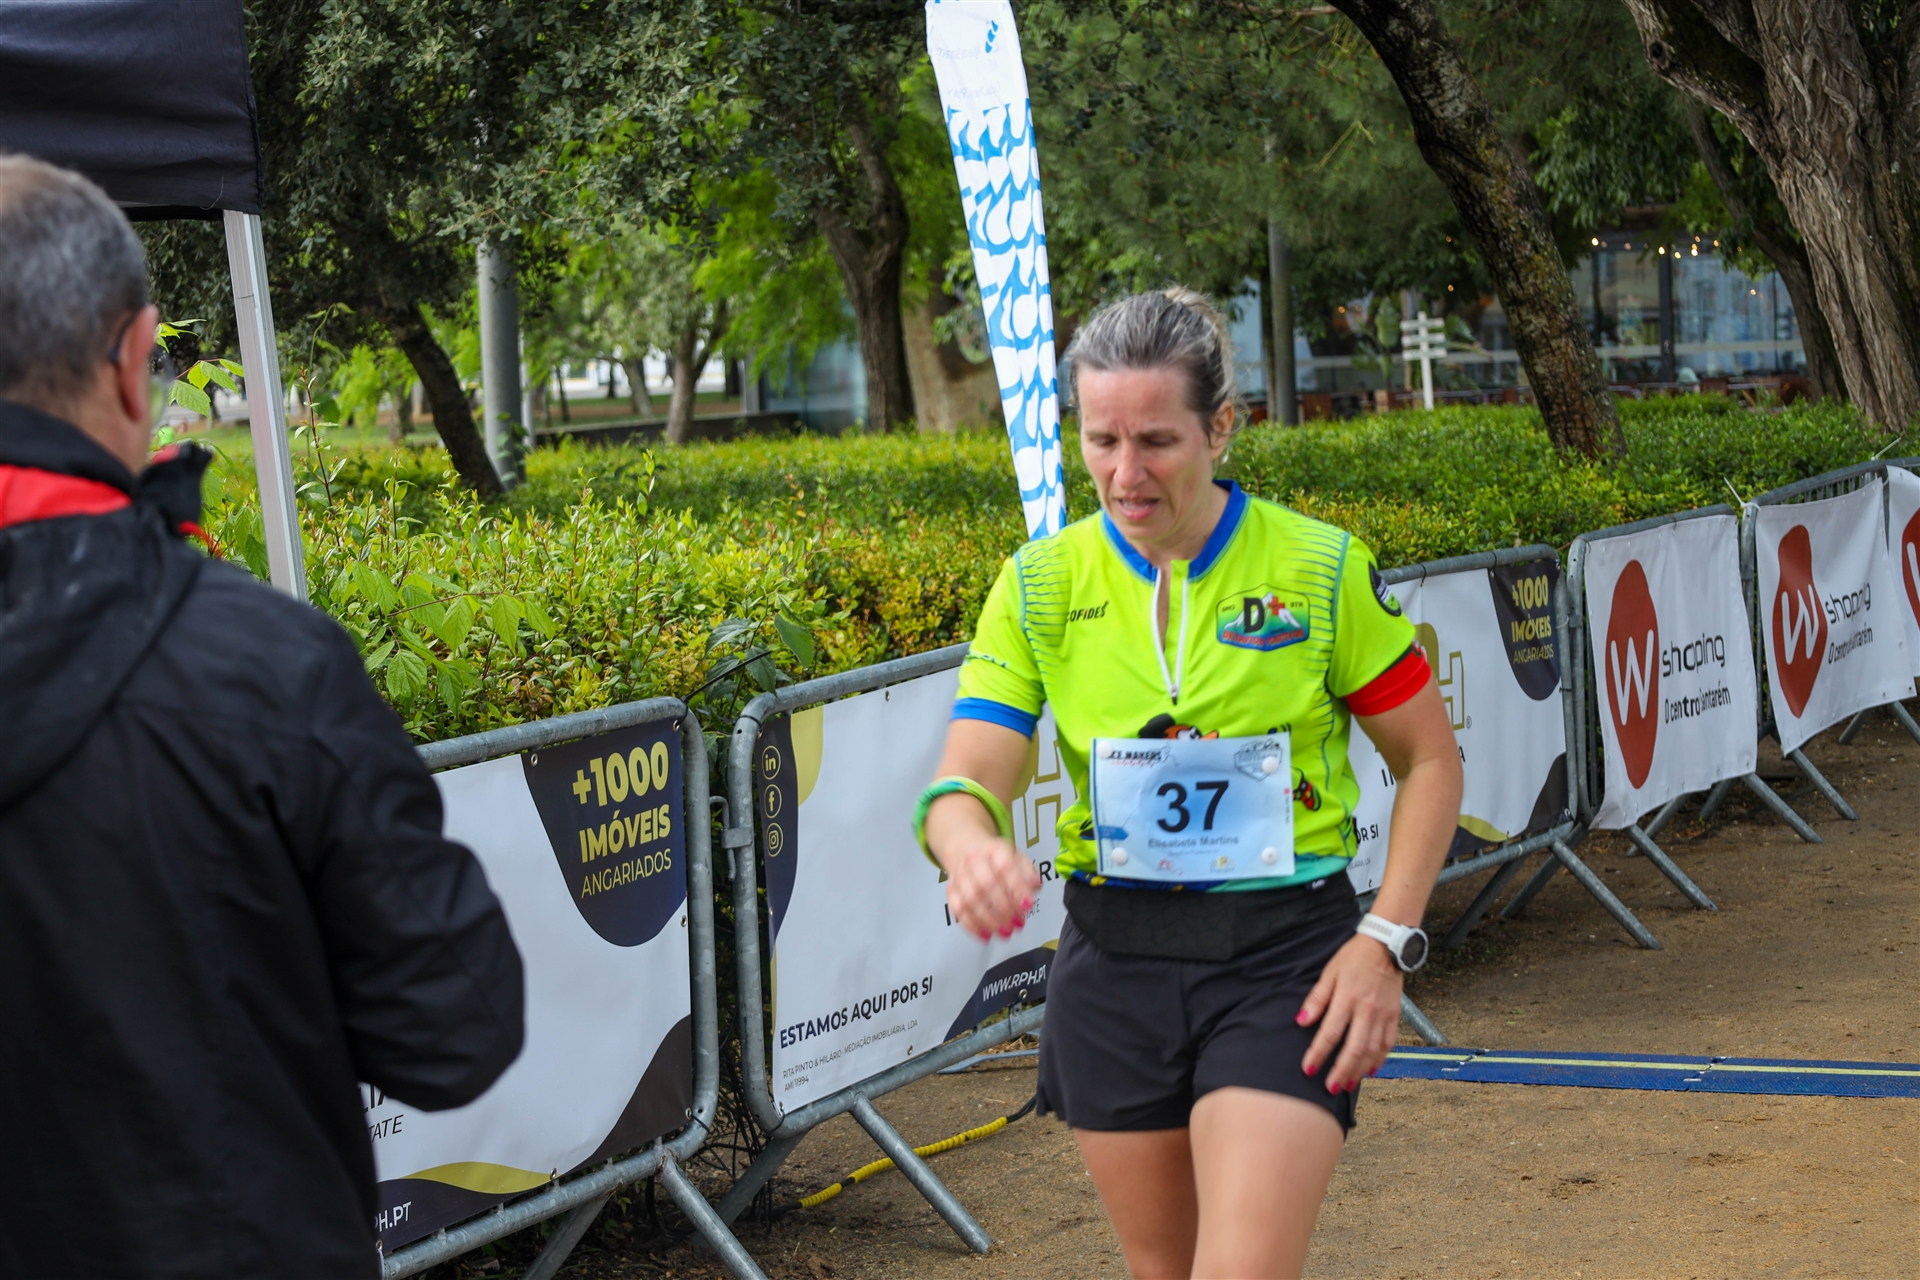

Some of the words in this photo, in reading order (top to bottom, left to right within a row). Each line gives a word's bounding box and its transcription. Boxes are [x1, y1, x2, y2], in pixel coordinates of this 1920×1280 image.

[1512, 574, 1549, 610] +1000
[1511, 613, 1552, 642] IMÓVEIS
[572, 741, 669, 807] +1000
[1156, 780, 1229, 833] 37
[579, 804, 671, 863] IMÓVEIS
[581, 848, 672, 898] ANGARIADOS
[982, 964, 1047, 1002] WWW.RPH.PT
[780, 1007, 848, 1049] ESTAMOS
[851, 993, 887, 1022] AQUI
[891, 981, 918, 1008] POR
[921, 975, 933, 995] SI
[783, 1067, 795, 1079] RITA
[795, 1060, 814, 1075] PINTO
[819, 1049, 842, 1064] HILÁRIO
[844, 1035, 872, 1055] MEDIAÇÃO
[907, 1019, 918, 1030] LDA
[784, 1081, 794, 1093] AMI
